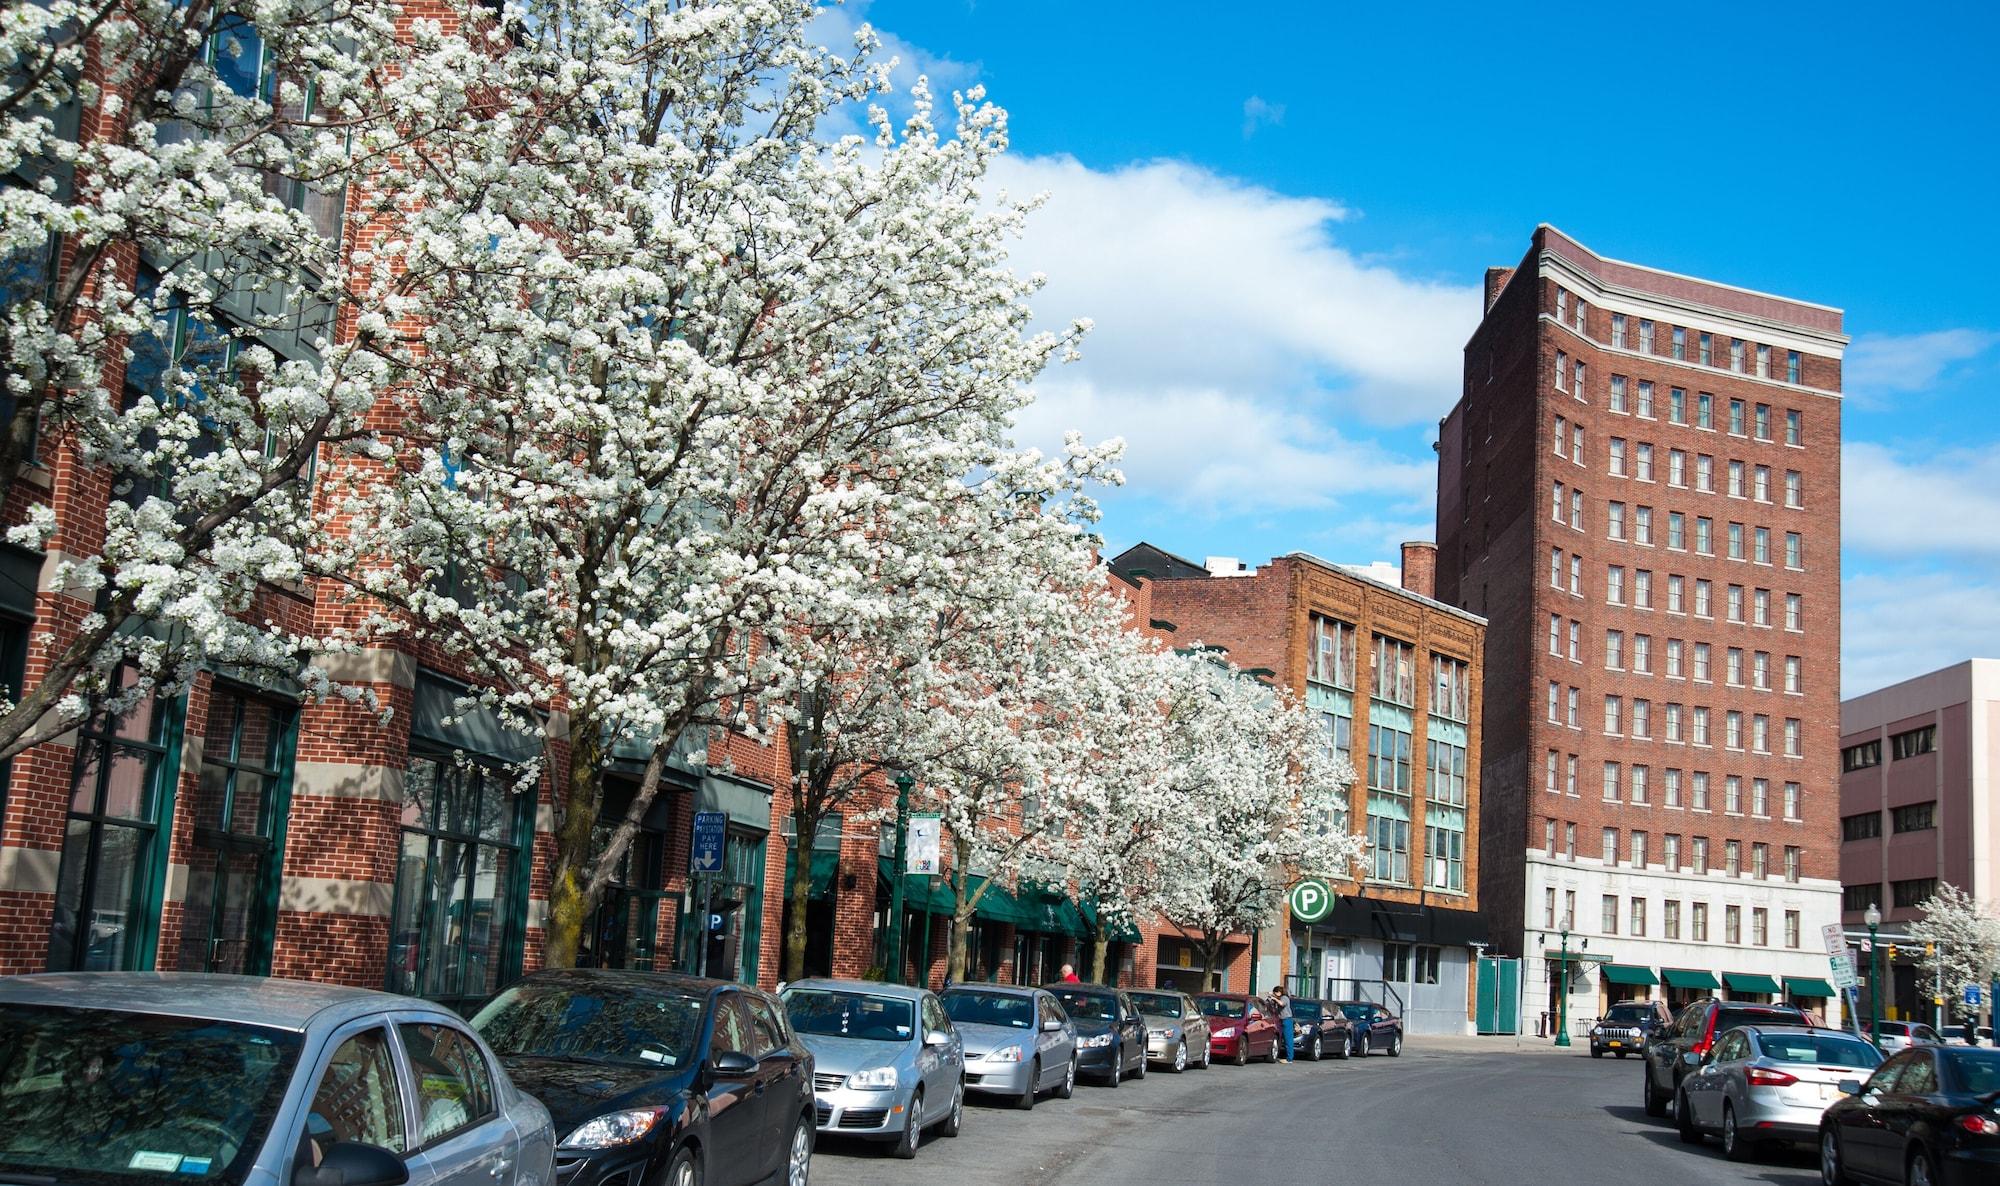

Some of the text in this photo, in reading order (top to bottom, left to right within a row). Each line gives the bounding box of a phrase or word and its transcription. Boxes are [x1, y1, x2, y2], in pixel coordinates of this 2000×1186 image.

[697, 815, 723, 824] PARKING
[702, 834, 716, 842] PAY
[1302, 889, 1318, 911] P
[711, 915, 721, 929] P
[1827, 926, 1836, 934] NO
[1831, 959, 1837, 969] 2
